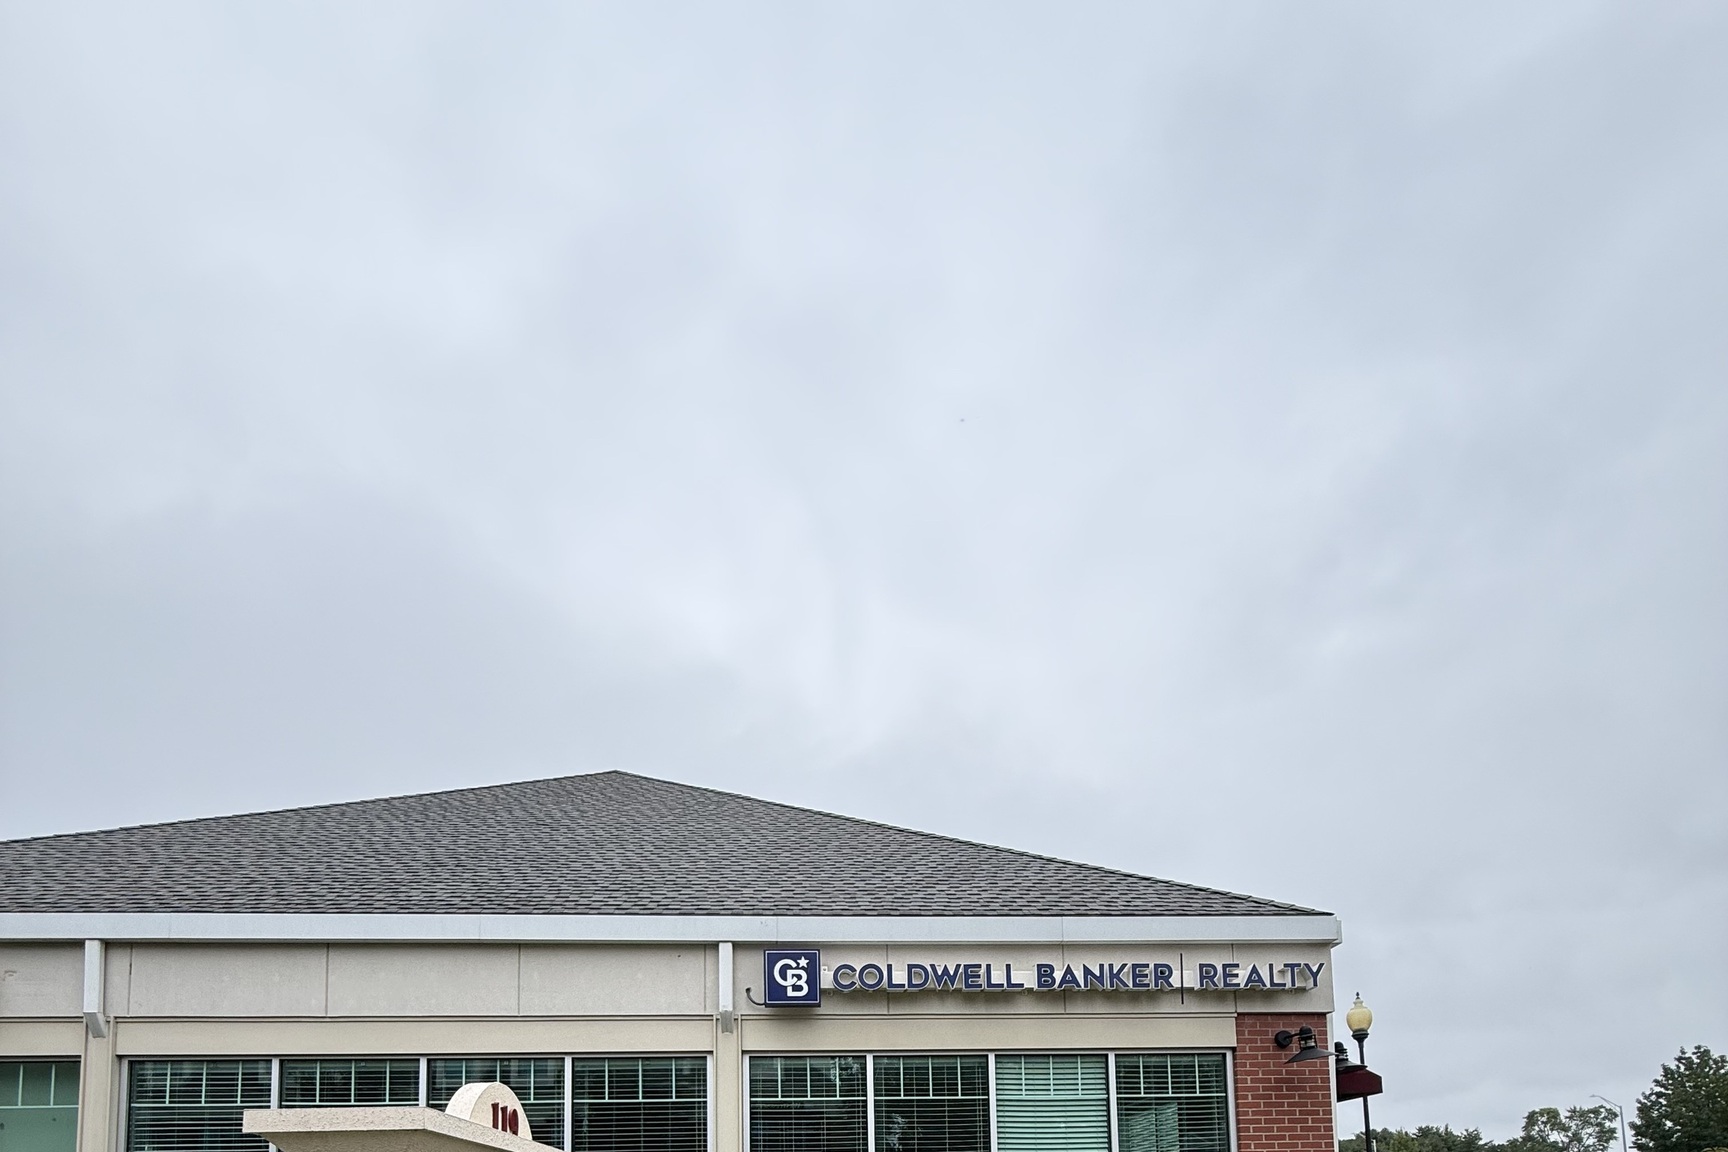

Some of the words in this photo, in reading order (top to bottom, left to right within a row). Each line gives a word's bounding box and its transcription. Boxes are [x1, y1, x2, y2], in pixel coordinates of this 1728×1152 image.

[774, 959, 809, 997] CB
[832, 963, 1025, 991] COLDWELL
[1034, 962, 1175, 990] BANKER
[1197, 962, 1326, 989] REALTY
